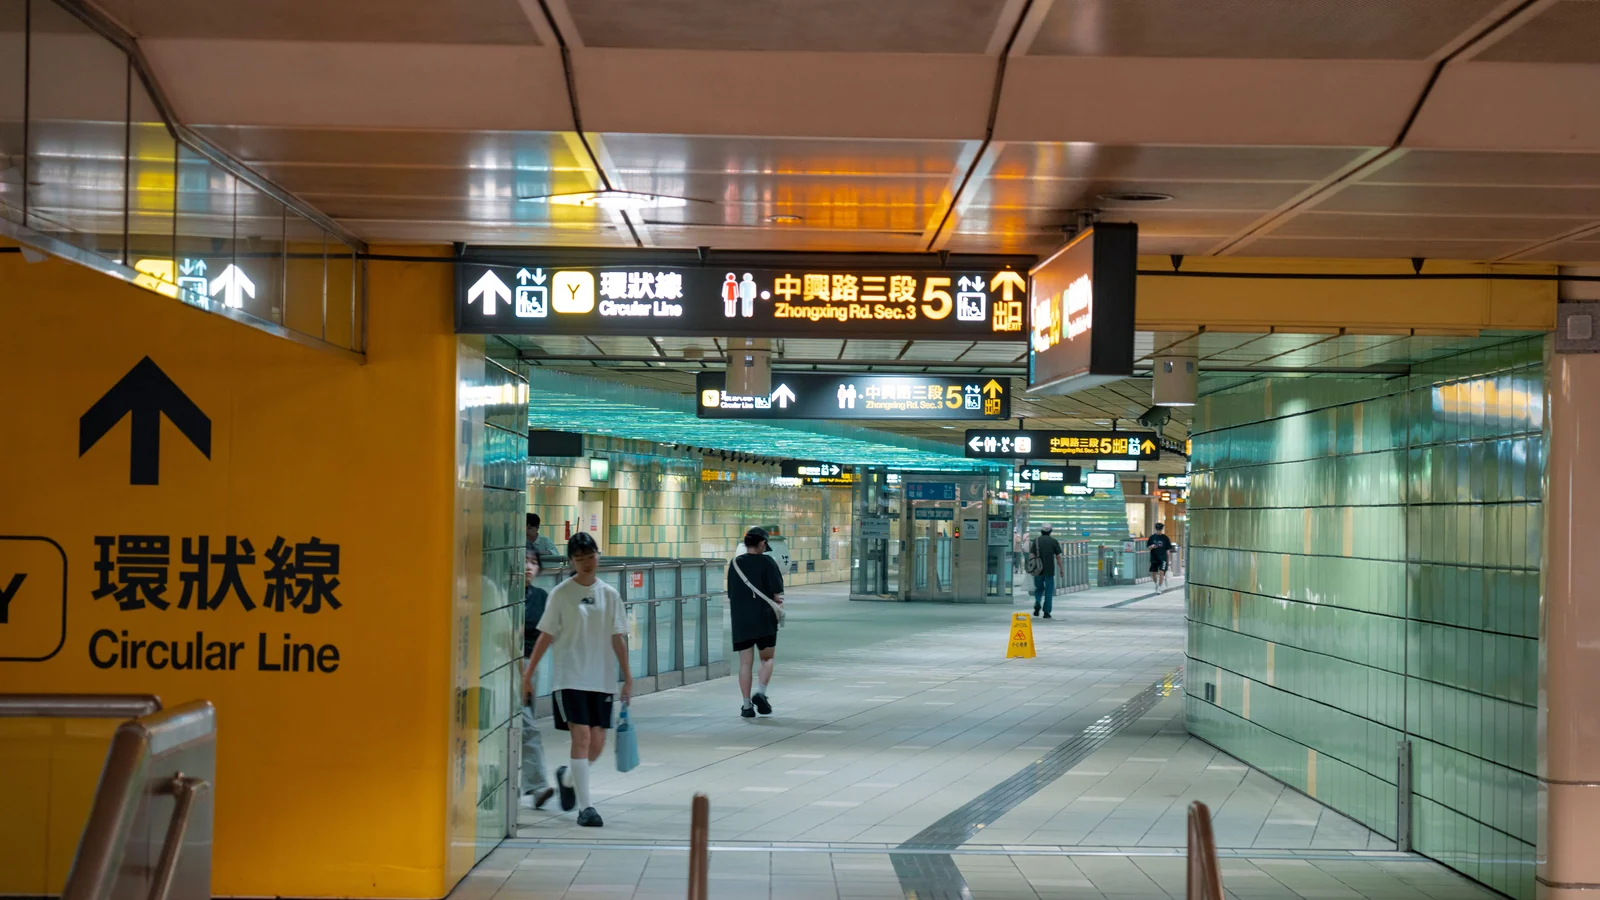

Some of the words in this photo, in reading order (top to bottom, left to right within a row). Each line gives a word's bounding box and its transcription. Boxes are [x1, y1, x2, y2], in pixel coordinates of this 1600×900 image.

[567, 284, 580, 300] Y
[600, 272, 683, 299] 環狀線
[774, 274, 917, 302] 中興路三段
[599, 300, 652, 316] Circular
[653, 301, 682, 316] Line
[921, 277, 953, 320] 5
[774, 303, 848, 322] Zhongxing
[850, 303, 873, 319] Rd.
[874, 303, 905, 320] Sec.
[906, 304, 917, 319] 3
[993, 301, 1023, 331] 出口
[1008, 322, 1022, 331] EXIT
[866, 385, 943, 400] 中興路三段
[946, 386, 962, 409] 5
[866, 401, 906, 411] Zhongxing
[907, 401, 919, 409] Rd.
[920, 401, 937, 409] Sec.
[938, 401, 943, 409] 3
[1050, 437, 1099, 447] 中興路三段
[1100, 438, 1112, 454] 5
[91, 535, 343, 614] 環狀線
[89, 628, 245, 669] Circular
[258, 632, 342, 673] Line
